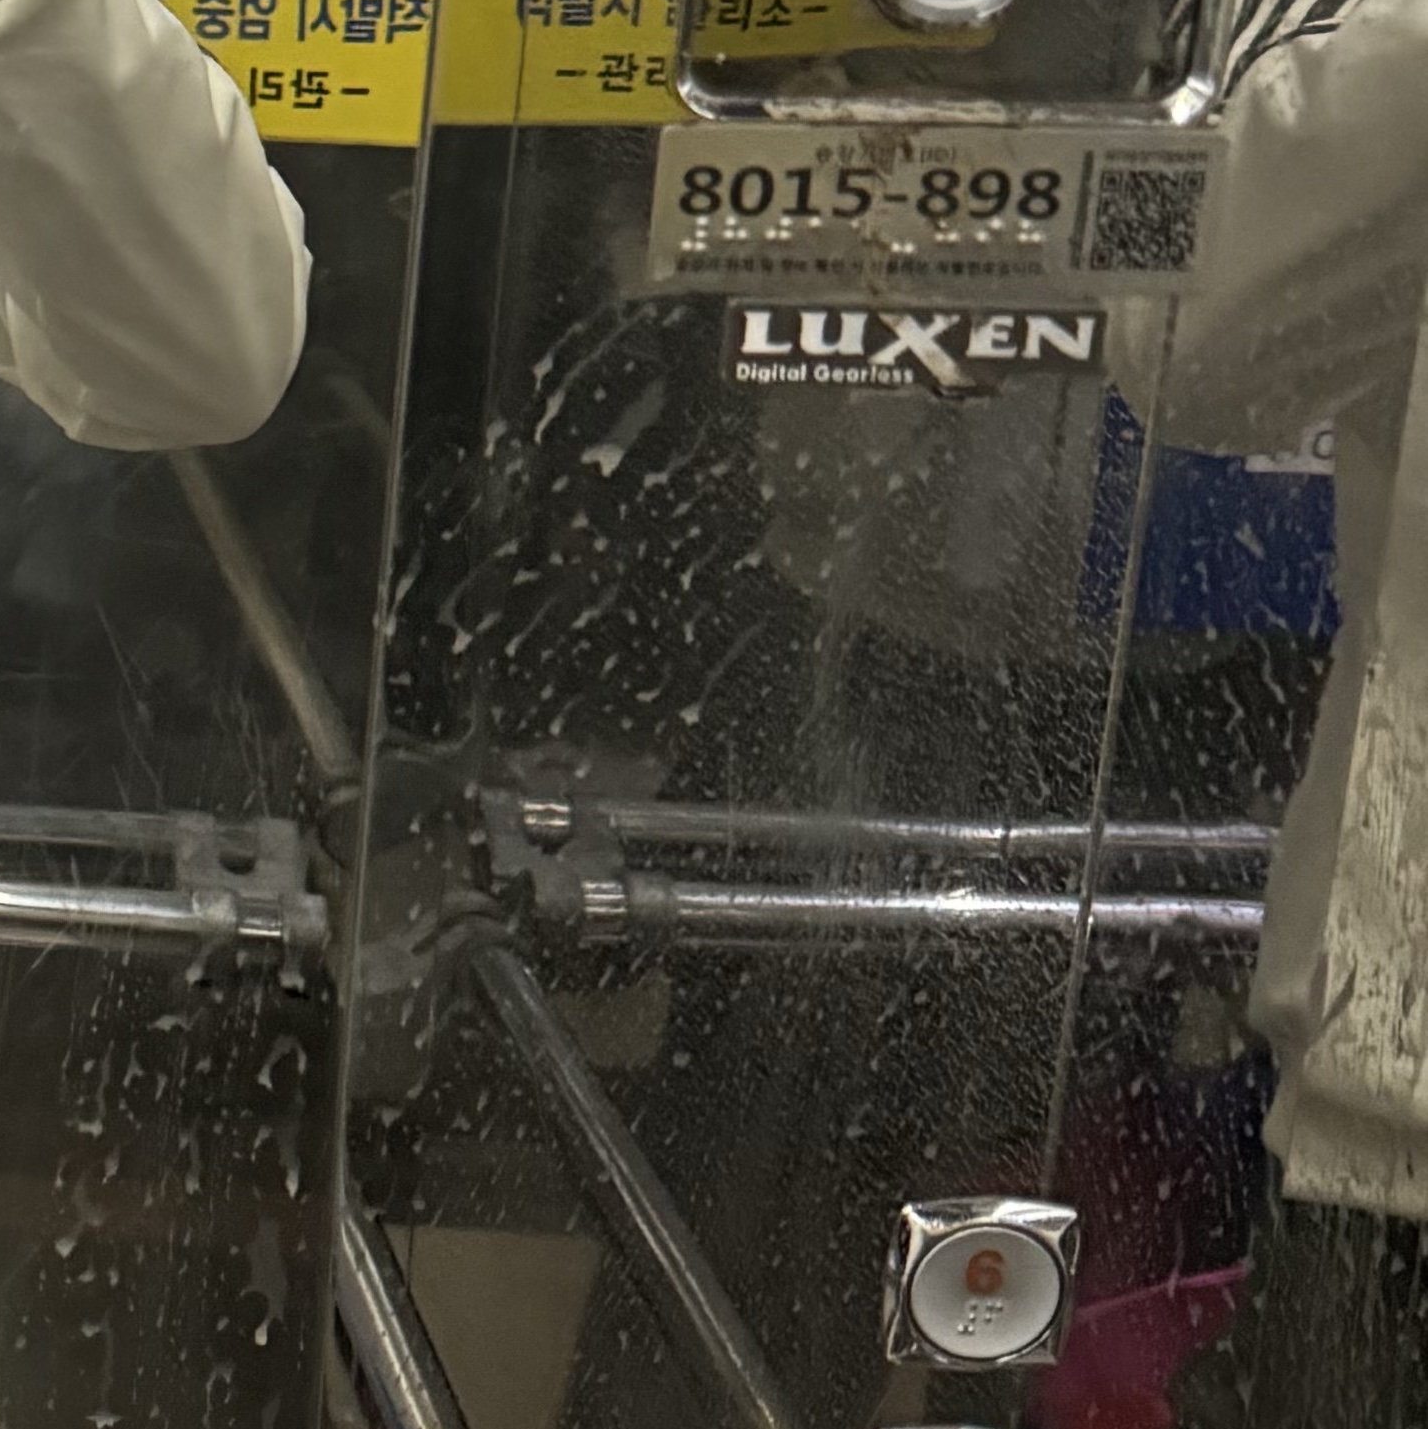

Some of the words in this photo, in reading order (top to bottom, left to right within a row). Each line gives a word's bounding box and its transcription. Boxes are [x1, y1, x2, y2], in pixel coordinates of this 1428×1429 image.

[678, 165, 1062, 220] 8015-898
[735, 361, 807, 384] Digital
[813, 362, 914, 383] Gearless
[739, 310, 1096, 384] LUXEN
[965, 1248, 1006, 1296] 6
